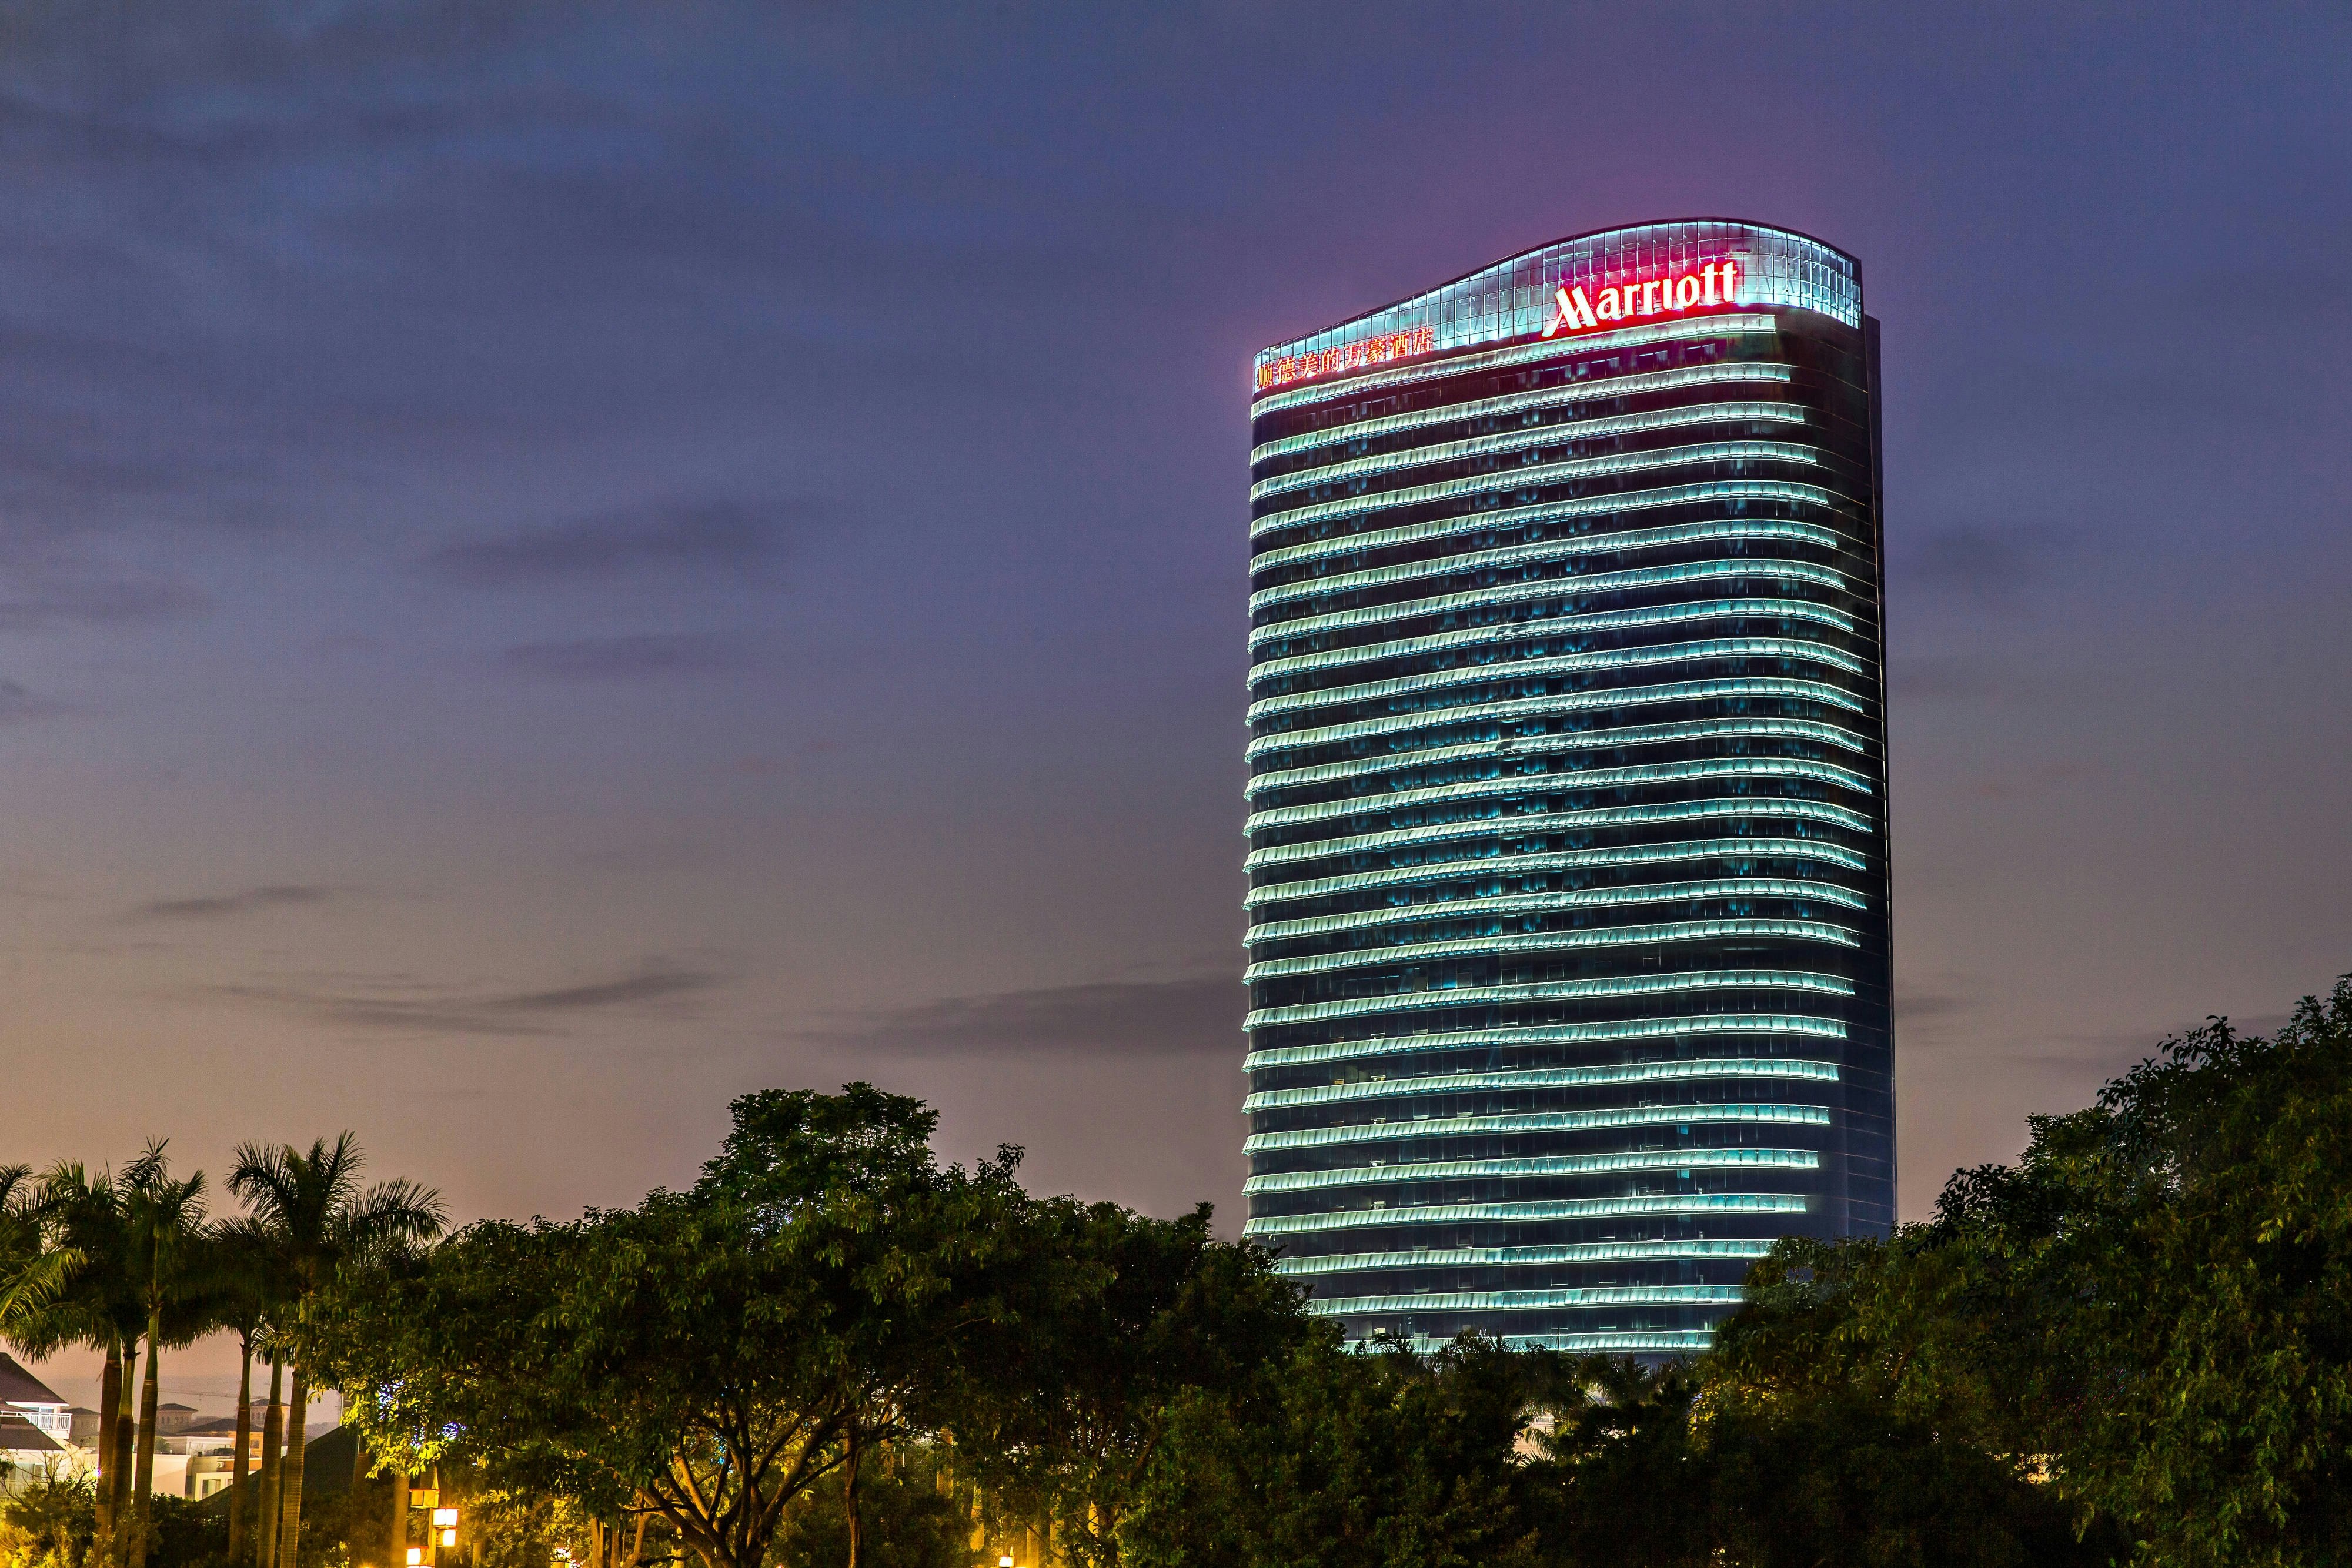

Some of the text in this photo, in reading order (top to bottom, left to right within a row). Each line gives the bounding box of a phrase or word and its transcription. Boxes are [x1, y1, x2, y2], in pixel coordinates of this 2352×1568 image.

[1541, 261, 1738, 337] Marriott
[1257, 327, 1434, 389] 顺德美的万豪酒店
